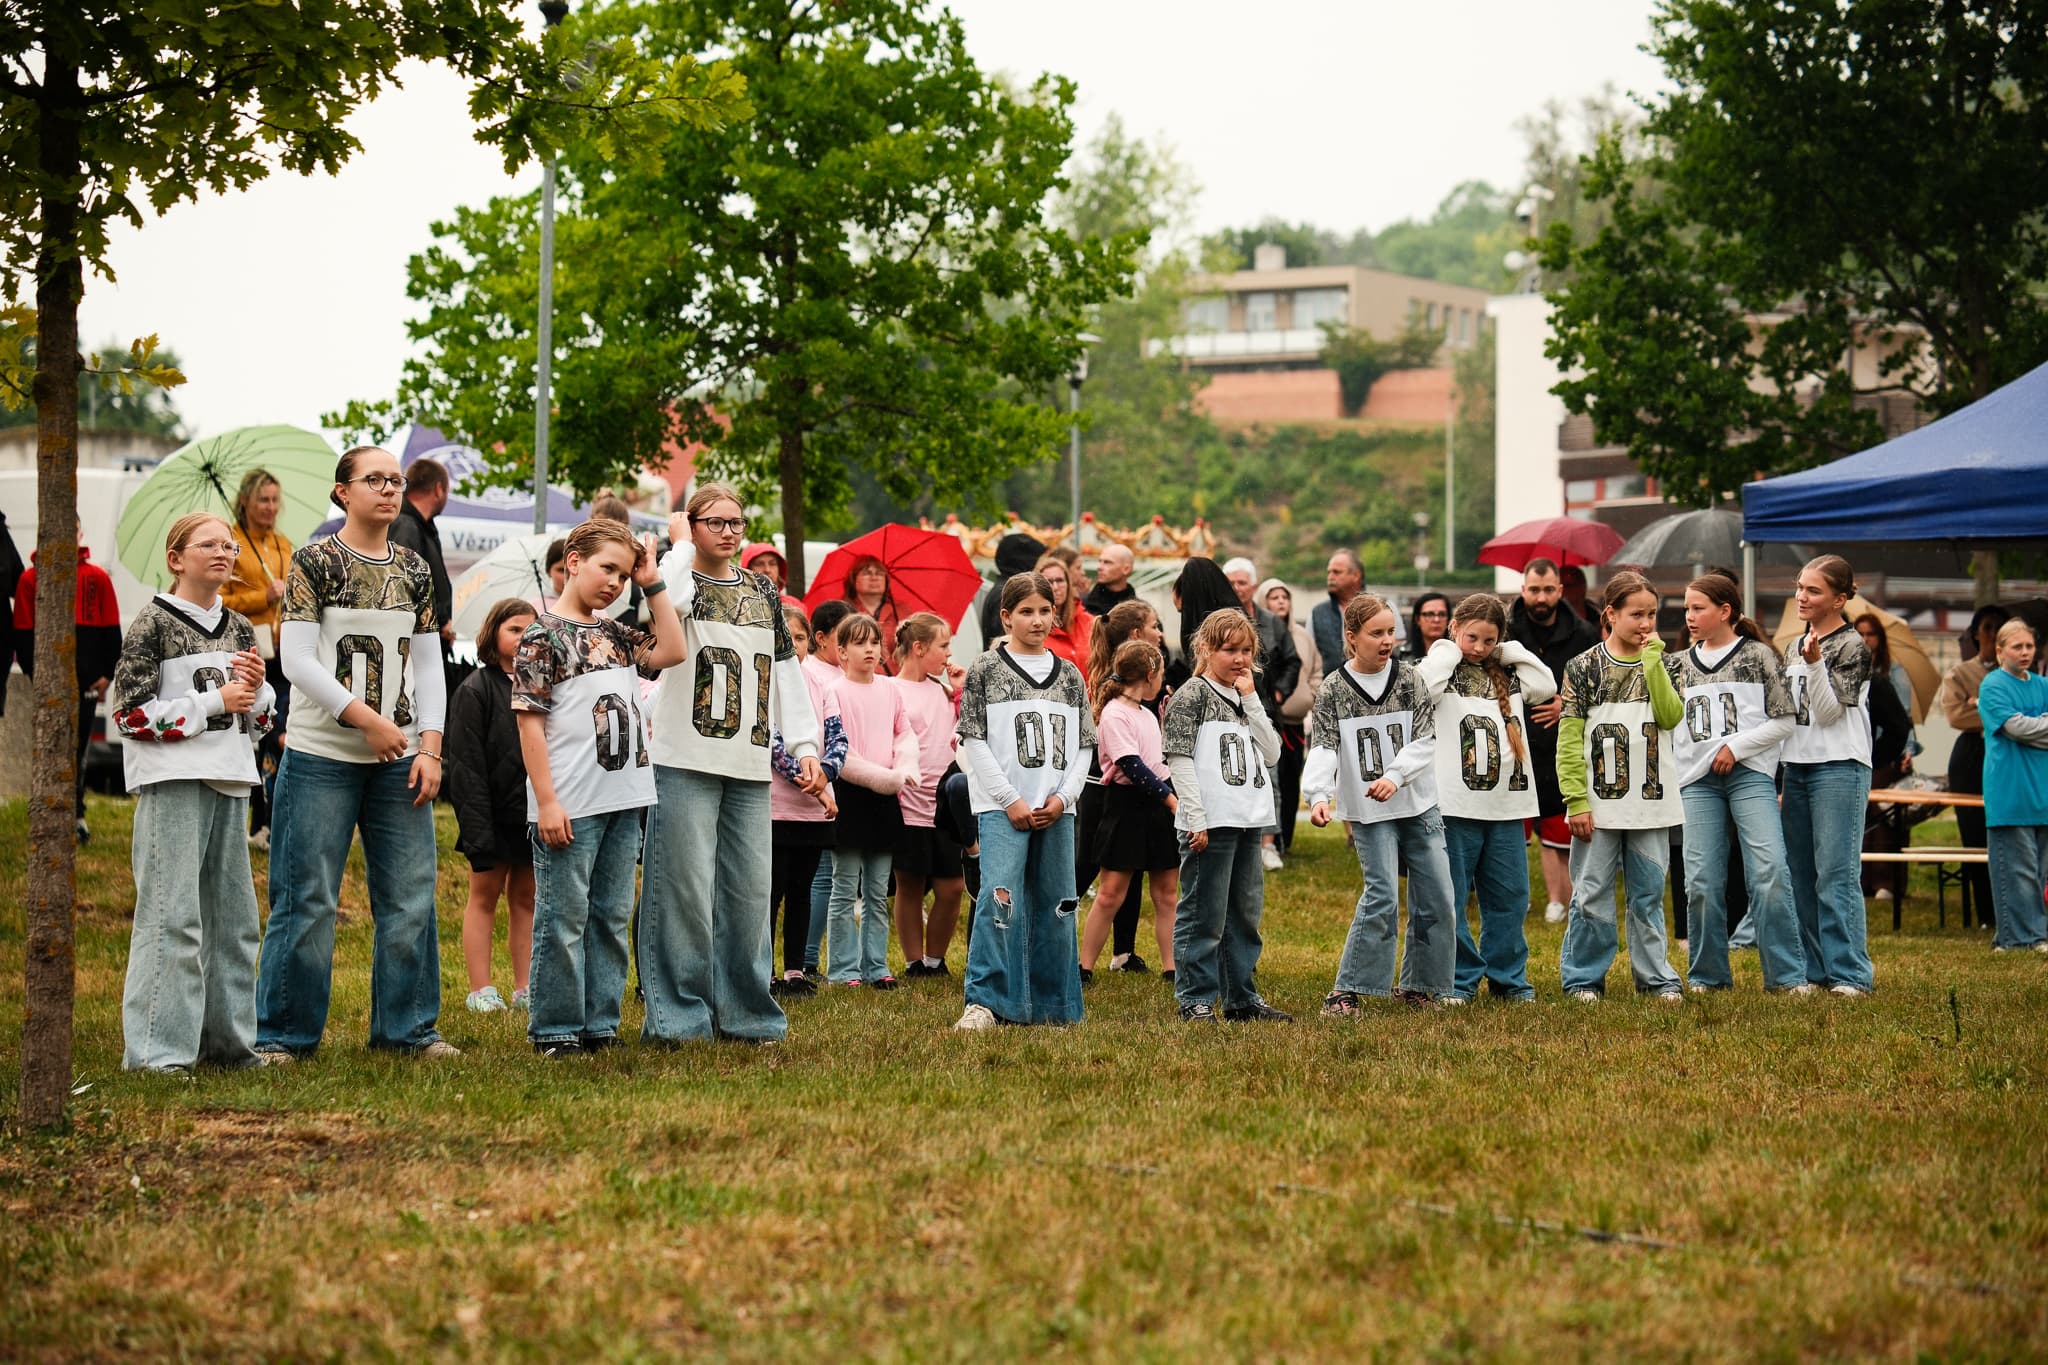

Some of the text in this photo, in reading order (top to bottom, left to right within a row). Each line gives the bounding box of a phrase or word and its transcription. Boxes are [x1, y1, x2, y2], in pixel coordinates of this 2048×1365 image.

[335, 634, 413, 728] 01
[692, 646, 771, 748] 01
[592, 692, 650, 772] 01
[1015, 711, 1068, 771] 01
[1356, 723, 1405, 782] 01
[1686, 693, 1738, 743] 01
[1219, 732, 1266, 789] 01
[1591, 722, 1664, 800] 01
